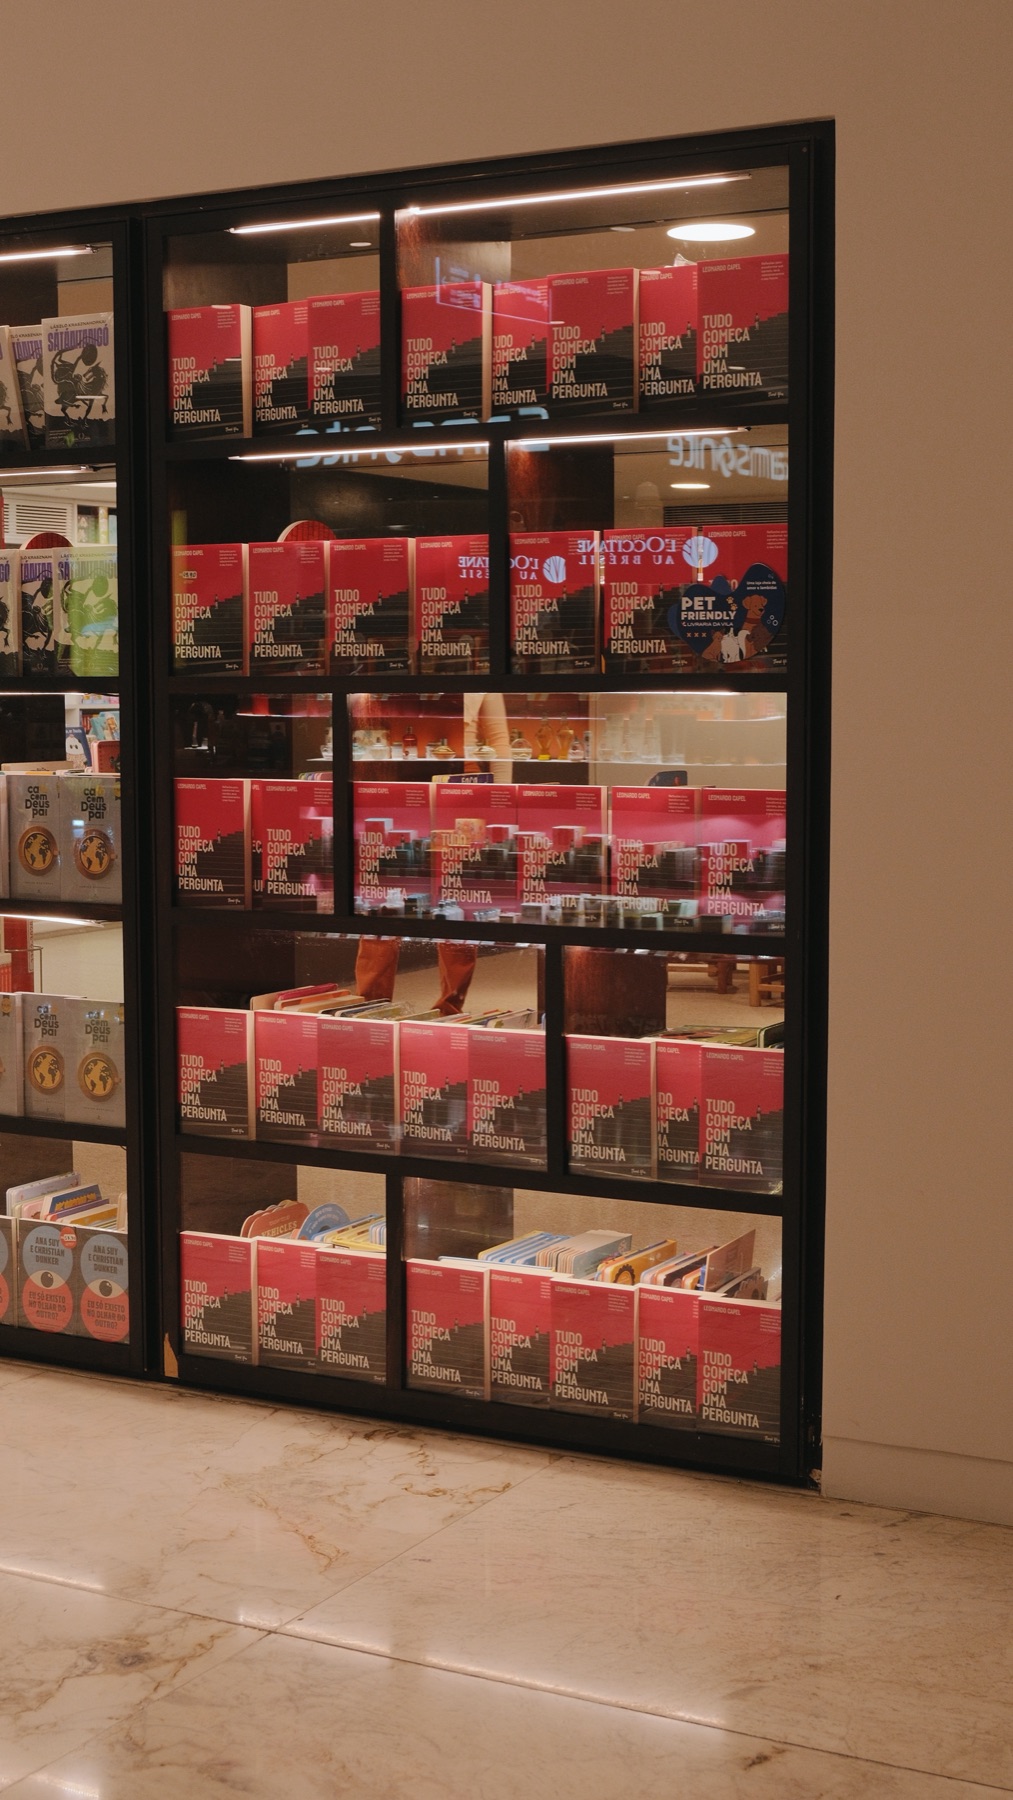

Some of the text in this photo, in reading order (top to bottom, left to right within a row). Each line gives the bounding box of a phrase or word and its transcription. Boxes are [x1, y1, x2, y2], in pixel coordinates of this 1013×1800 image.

[702, 313, 732, 329] TUDO
[552, 326, 580, 340] TUDO
[703, 327, 750, 344] COMEÇA
[407, 338, 432, 352] TUDO
[553, 339, 596, 355] COMEÇA
[703, 344, 728, 359] COM
[172, 357, 195, 370] TUDO
[407, 351, 448, 366] COMEÇA
[553, 355, 575, 369] COM
[407, 366, 428, 380] COM
[703, 359, 728, 374] UMA
[173, 369, 210, 383] COMEÇA
[553, 370, 575, 384] UMA
[703, 371, 762, 389] PERGUNTA
[173, 384, 192, 397] COM
[407, 380, 428, 394] UMA
[552, 382, 607, 399] PERGUNTA
[173, 397, 193, 410] UMA
[407, 392, 458, 408] PERGUNTA
[174, 409, 220, 424] PERGUNTA
[334, 589, 359, 602] TUDO
[610, 582, 638, 595] TUDO
[254, 591, 278, 603] TUDO
[610, 596, 654, 610] COMEÇA
[682, 596, 715, 610] PET
[254, 604, 292, 617] COMEÇA
[335, 603, 374, 616] COMEÇA
[681, 611, 736, 620] FRIENDLY
[254, 618, 274, 630] COM
[335, 617, 355, 629] COM
[610, 611, 634, 624] COM
[254, 632, 274, 644] UMA
[335, 630, 355, 643] UMA
[611, 626, 634, 639] UMA
[254, 644, 302, 657] PERGUNTA
[335, 644, 384, 656] PERGUNTA
[611, 639, 666, 654] PERGUNTA
[25, 799, 50, 809] Deus
[81, 801, 106, 811] Deus
[32, 809, 47, 818] pai
[88, 811, 104, 821] pai
[178, 826, 200, 838] TUDO
[267, 829, 291, 841] TUDO
[178, 838, 214, 852] COMEÇA
[267, 842, 305, 856] COMEÇA
[178, 851, 197, 864] COM
[267, 855, 287, 868] COM
[178, 864, 197, 876] UMA
[268, 869, 287, 881] UMA
[179, 877, 223, 891] PERGUNTA
[268, 882, 315, 896] PERGUNTA
[34, 1018, 59, 1028] Deus
[85, 1024, 110, 1034] Deus
[41, 1028, 56, 1038] pai
[93, 1034, 108, 1044] pai
[180, 1054, 203, 1067] TUDO
[181, 1067, 217, 1082] COMEÇA
[322, 1067, 346, 1080] TUDO
[181, 1080, 200, 1093] COM
[322, 1080, 361, 1095] COMEÇA
[181, 1093, 200, 1105] UMA
[323, 1093, 343, 1106] COM
[181, 1105, 226, 1121] PERGUNTA
[323, 1106, 343, 1119] UMA
[706, 1099, 735, 1114] TUDO
[323, 1119, 371, 1136] PERGUNTA
[706, 1113, 752, 1130] COMEÇA
[706, 1127, 730, 1142] COM
[706, 1142, 729, 1156] UMA
[705, 1156, 763, 1174] PERGUNTA
[261, 1220, 297, 1237] VEHICLES
[36, 1236, 60, 1247] ANA SUY
[35, 1246, 65, 1257] CHRISTIAN
[93, 1245, 105, 1254] ANA
[36, 1255, 59, 1265] DUNKER
[93, 1254, 123, 1266] CHRISTIAN
[94, 1264, 118, 1274] DUNKER
[184, 1279, 207, 1293] TUDO
[46, 1294, 65, 1304] EXISTO
[185, 1292, 221, 1308] COMEÇA
[105, 1303, 125, 1313] EXISTO
[185, 1304, 204, 1318] COM
[704, 1305, 726, 1314] LEONARDO
[96, 1311, 116, 1320] OLHAR
[185, 1317, 204, 1331] UMA
[185, 1330, 230, 1347] PERGUNTA
[555, 1330, 582, 1345] TUDO
[556, 1344, 598, 1362] COMEÇA
[703, 1350, 731, 1367] TUDO
[556, 1357, 577, 1372] COM
[556, 1371, 577, 1386] UMA
[703, 1364, 748, 1384] COMEÇA
[703, 1378, 726, 1394] COM
[555, 1384, 608, 1404] PERGUNTA
[703, 1393, 726, 1408] UMA
[702, 1406, 759, 1428] PERGUNTA
